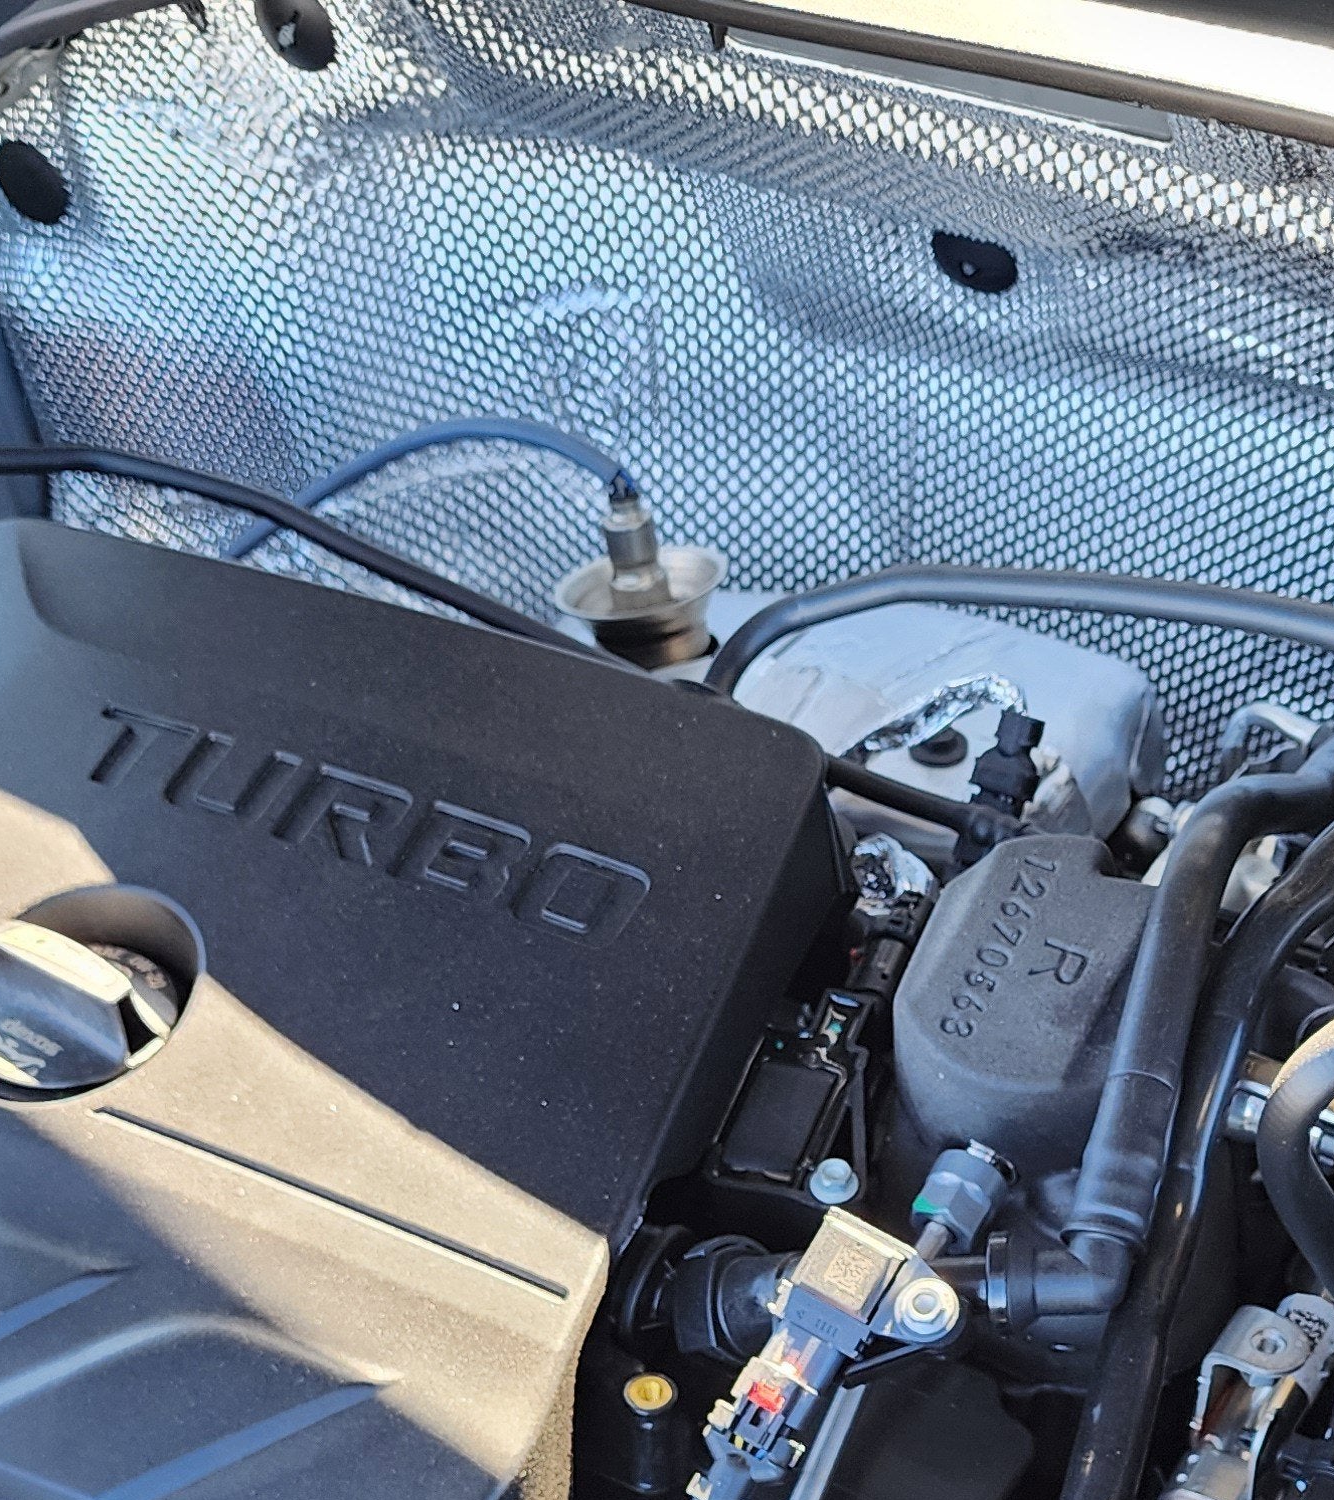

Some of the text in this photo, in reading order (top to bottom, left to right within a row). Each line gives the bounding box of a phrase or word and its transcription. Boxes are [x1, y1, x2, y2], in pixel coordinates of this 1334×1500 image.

[89, 705, 652, 948] TURBO
[939, 856, 1057, 1038] 12670563
[1027, 937, 1089, 985] R
